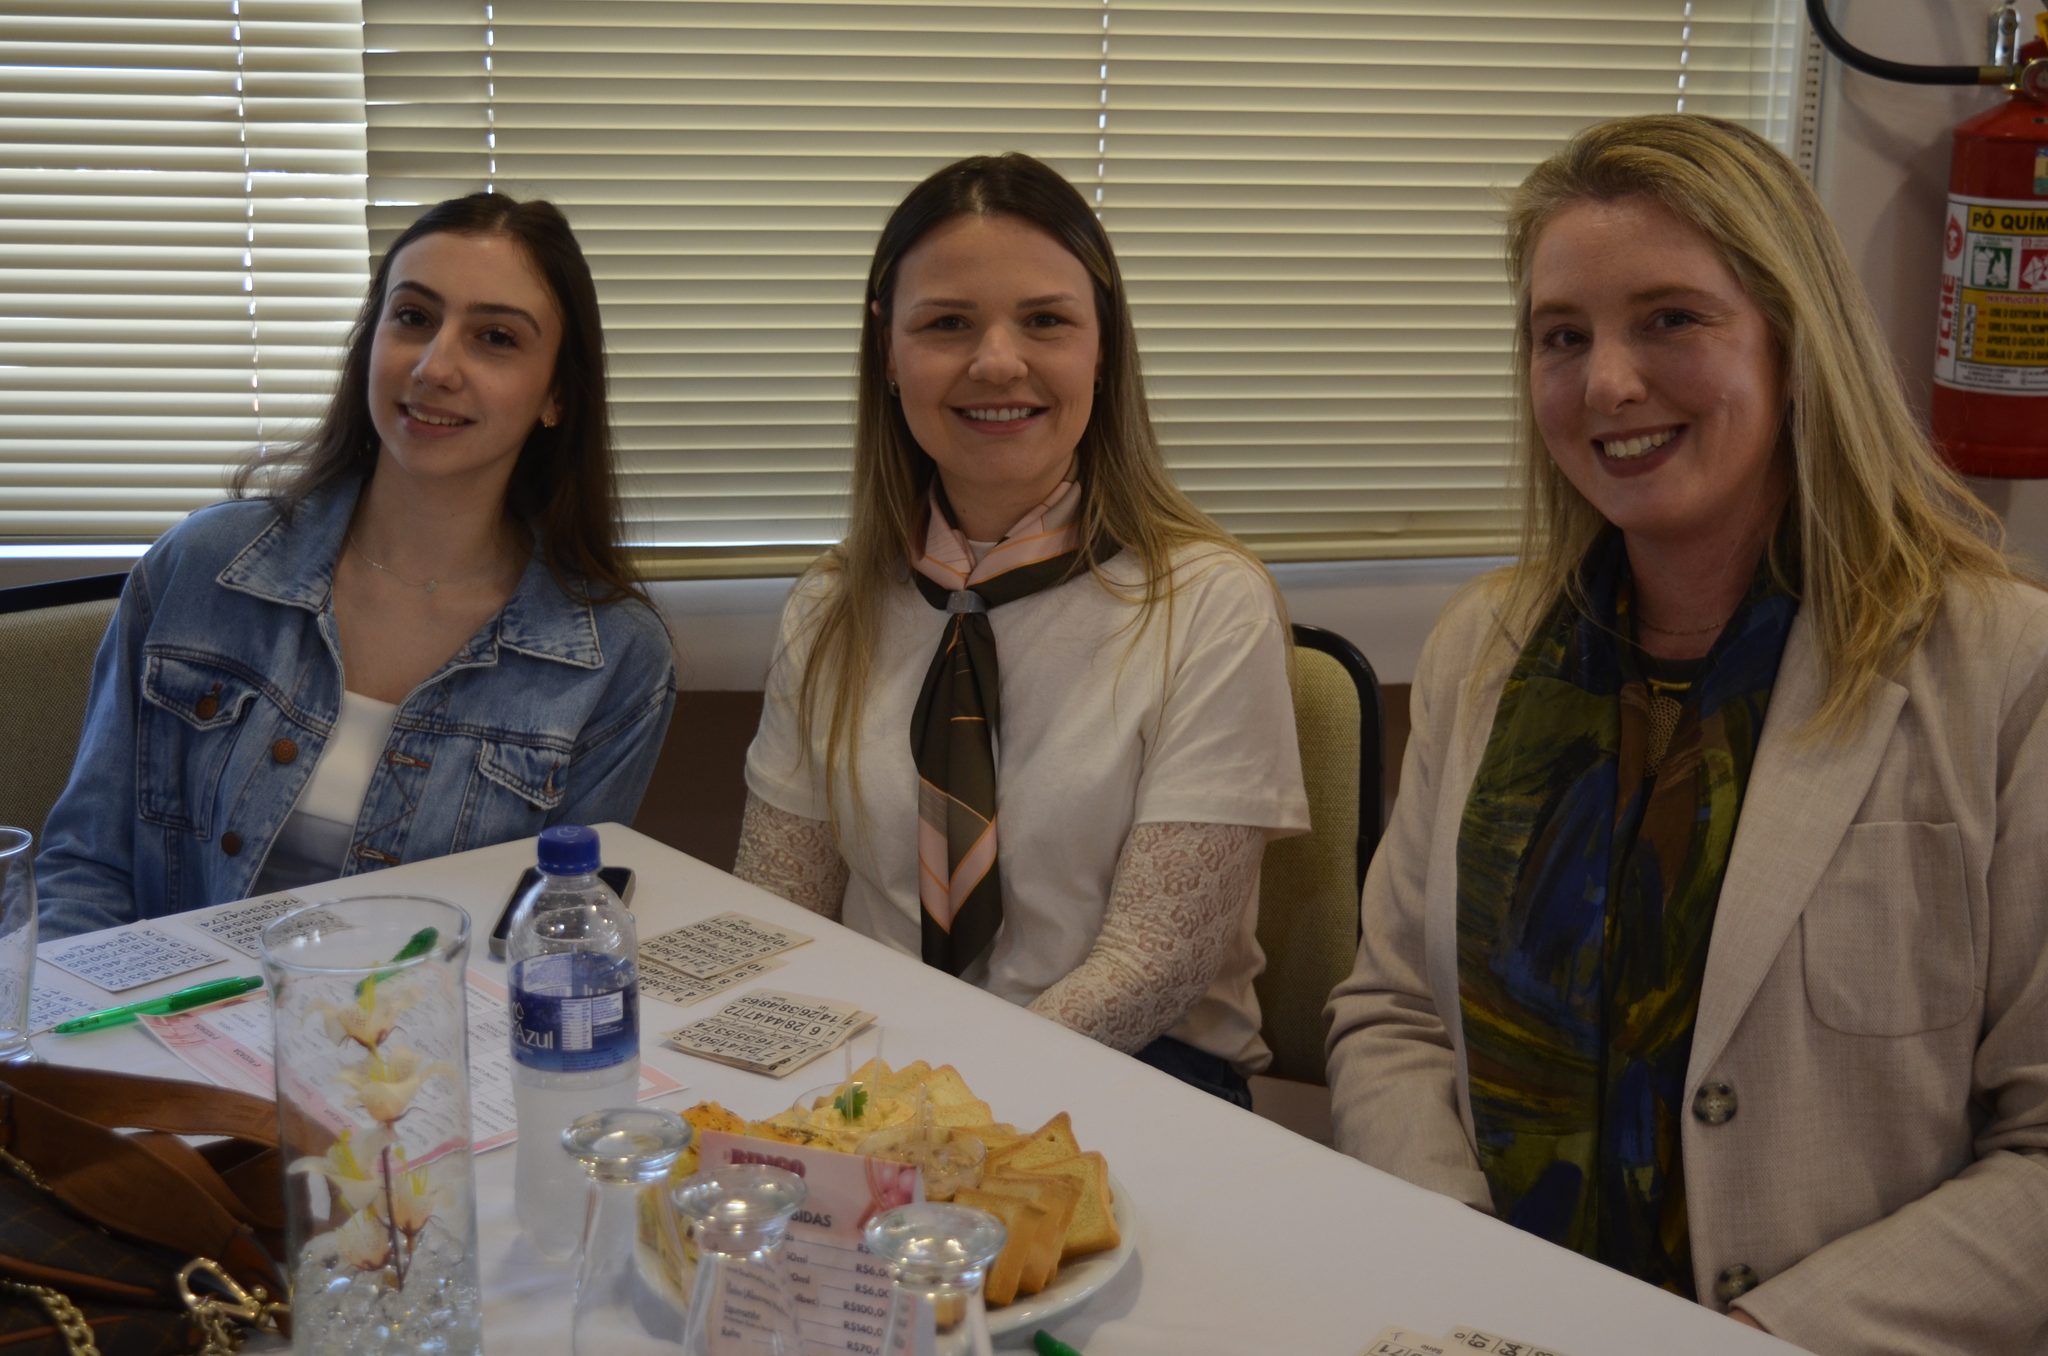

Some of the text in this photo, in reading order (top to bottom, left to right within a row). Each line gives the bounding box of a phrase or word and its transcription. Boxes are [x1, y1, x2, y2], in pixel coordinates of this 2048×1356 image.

[1972, 210, 2048, 230] PÓ QUÍM
[223, 913, 239, 921] 47
[200, 919, 219, 927] 74
[740, 997, 760, 1005] 65
[760, 1000, 779, 1010] 48
[780, 1004, 799, 1015] 38
[800, 1007, 820, 1019] 26
[723, 1005, 821, 1036] 6 28 44 47 72
[820, 1012, 840, 1024] 14
[693, 1022, 715, 1032] 74
[715, 1027, 735, 1037] 53
[678, 1029, 700, 1039] 73
[735, 1033, 755, 1042] 35
[698, 1035, 720, 1045] 50
[720, 1040, 739, 1050] 41
[754, 1037, 774, 1047] 16
[790, 1209, 832, 1228] BIDAS
[842, 1321, 884, 1338] R$140,0
[1468, 1333, 1491, 1349] 67
